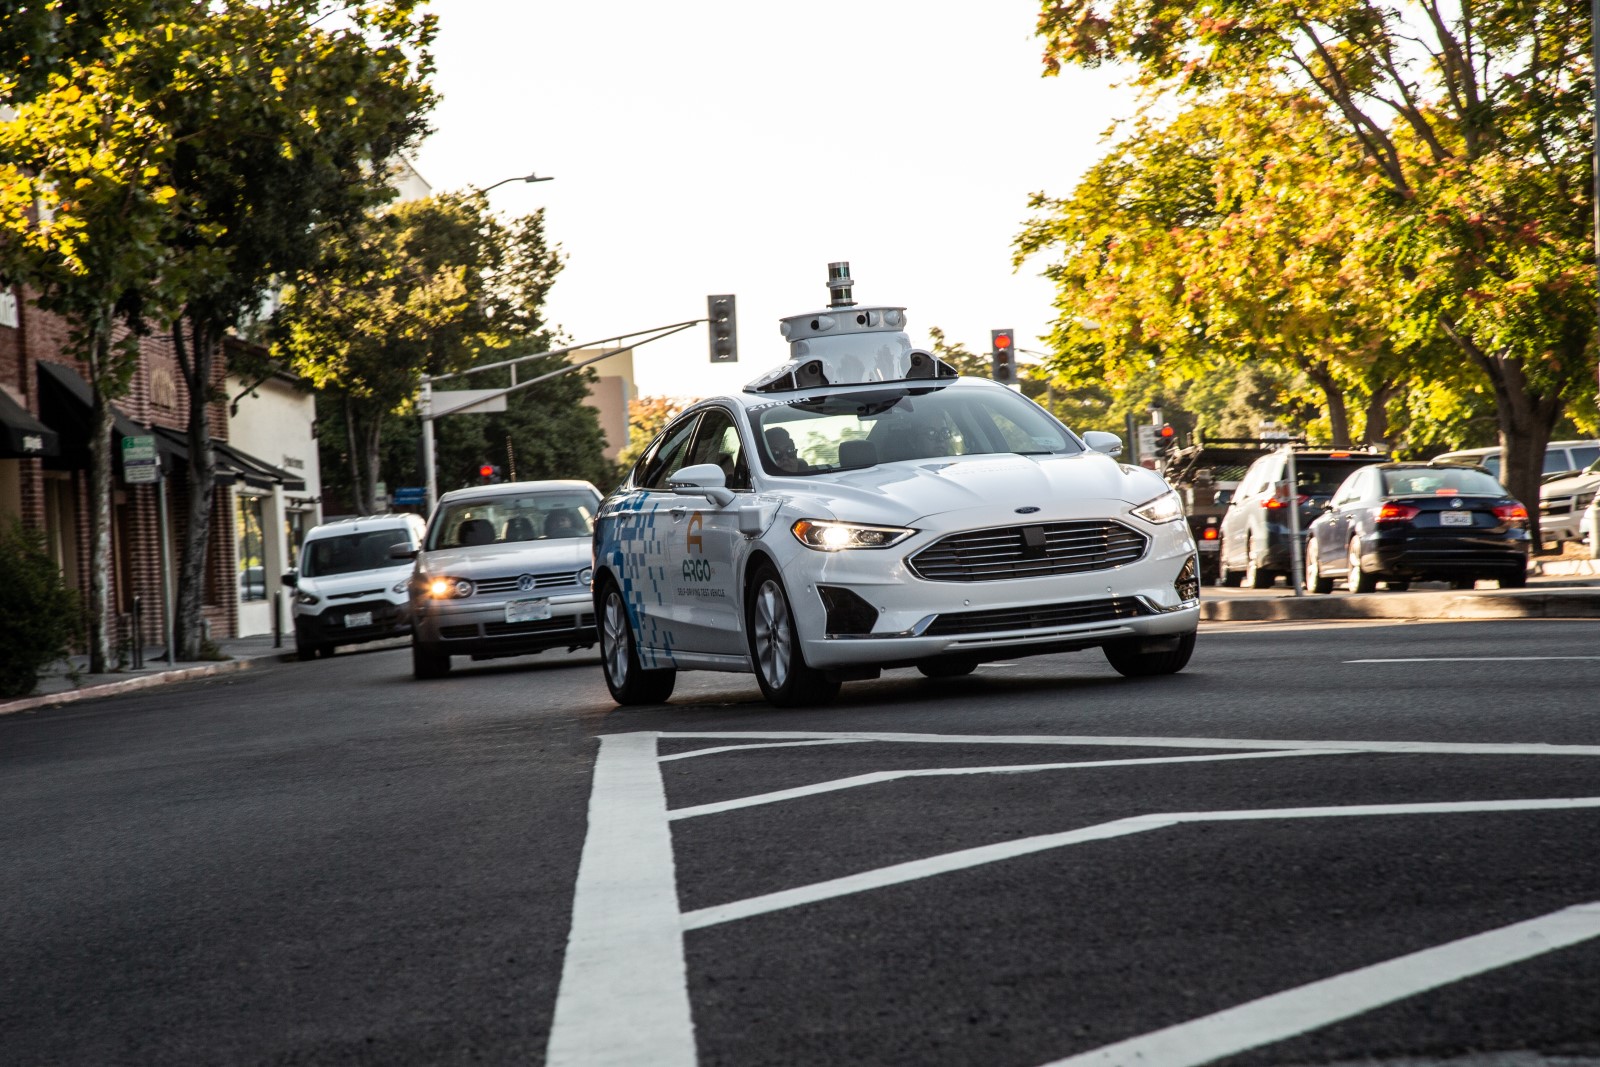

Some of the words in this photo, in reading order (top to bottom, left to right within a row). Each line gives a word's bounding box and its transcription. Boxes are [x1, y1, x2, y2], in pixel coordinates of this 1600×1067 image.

[682, 559, 711, 582] ARGO
[677, 587, 701, 597] SELF-DRIVING
[701, 588, 710, 597] TEST
[710, 588, 726, 598] VEHICLE
